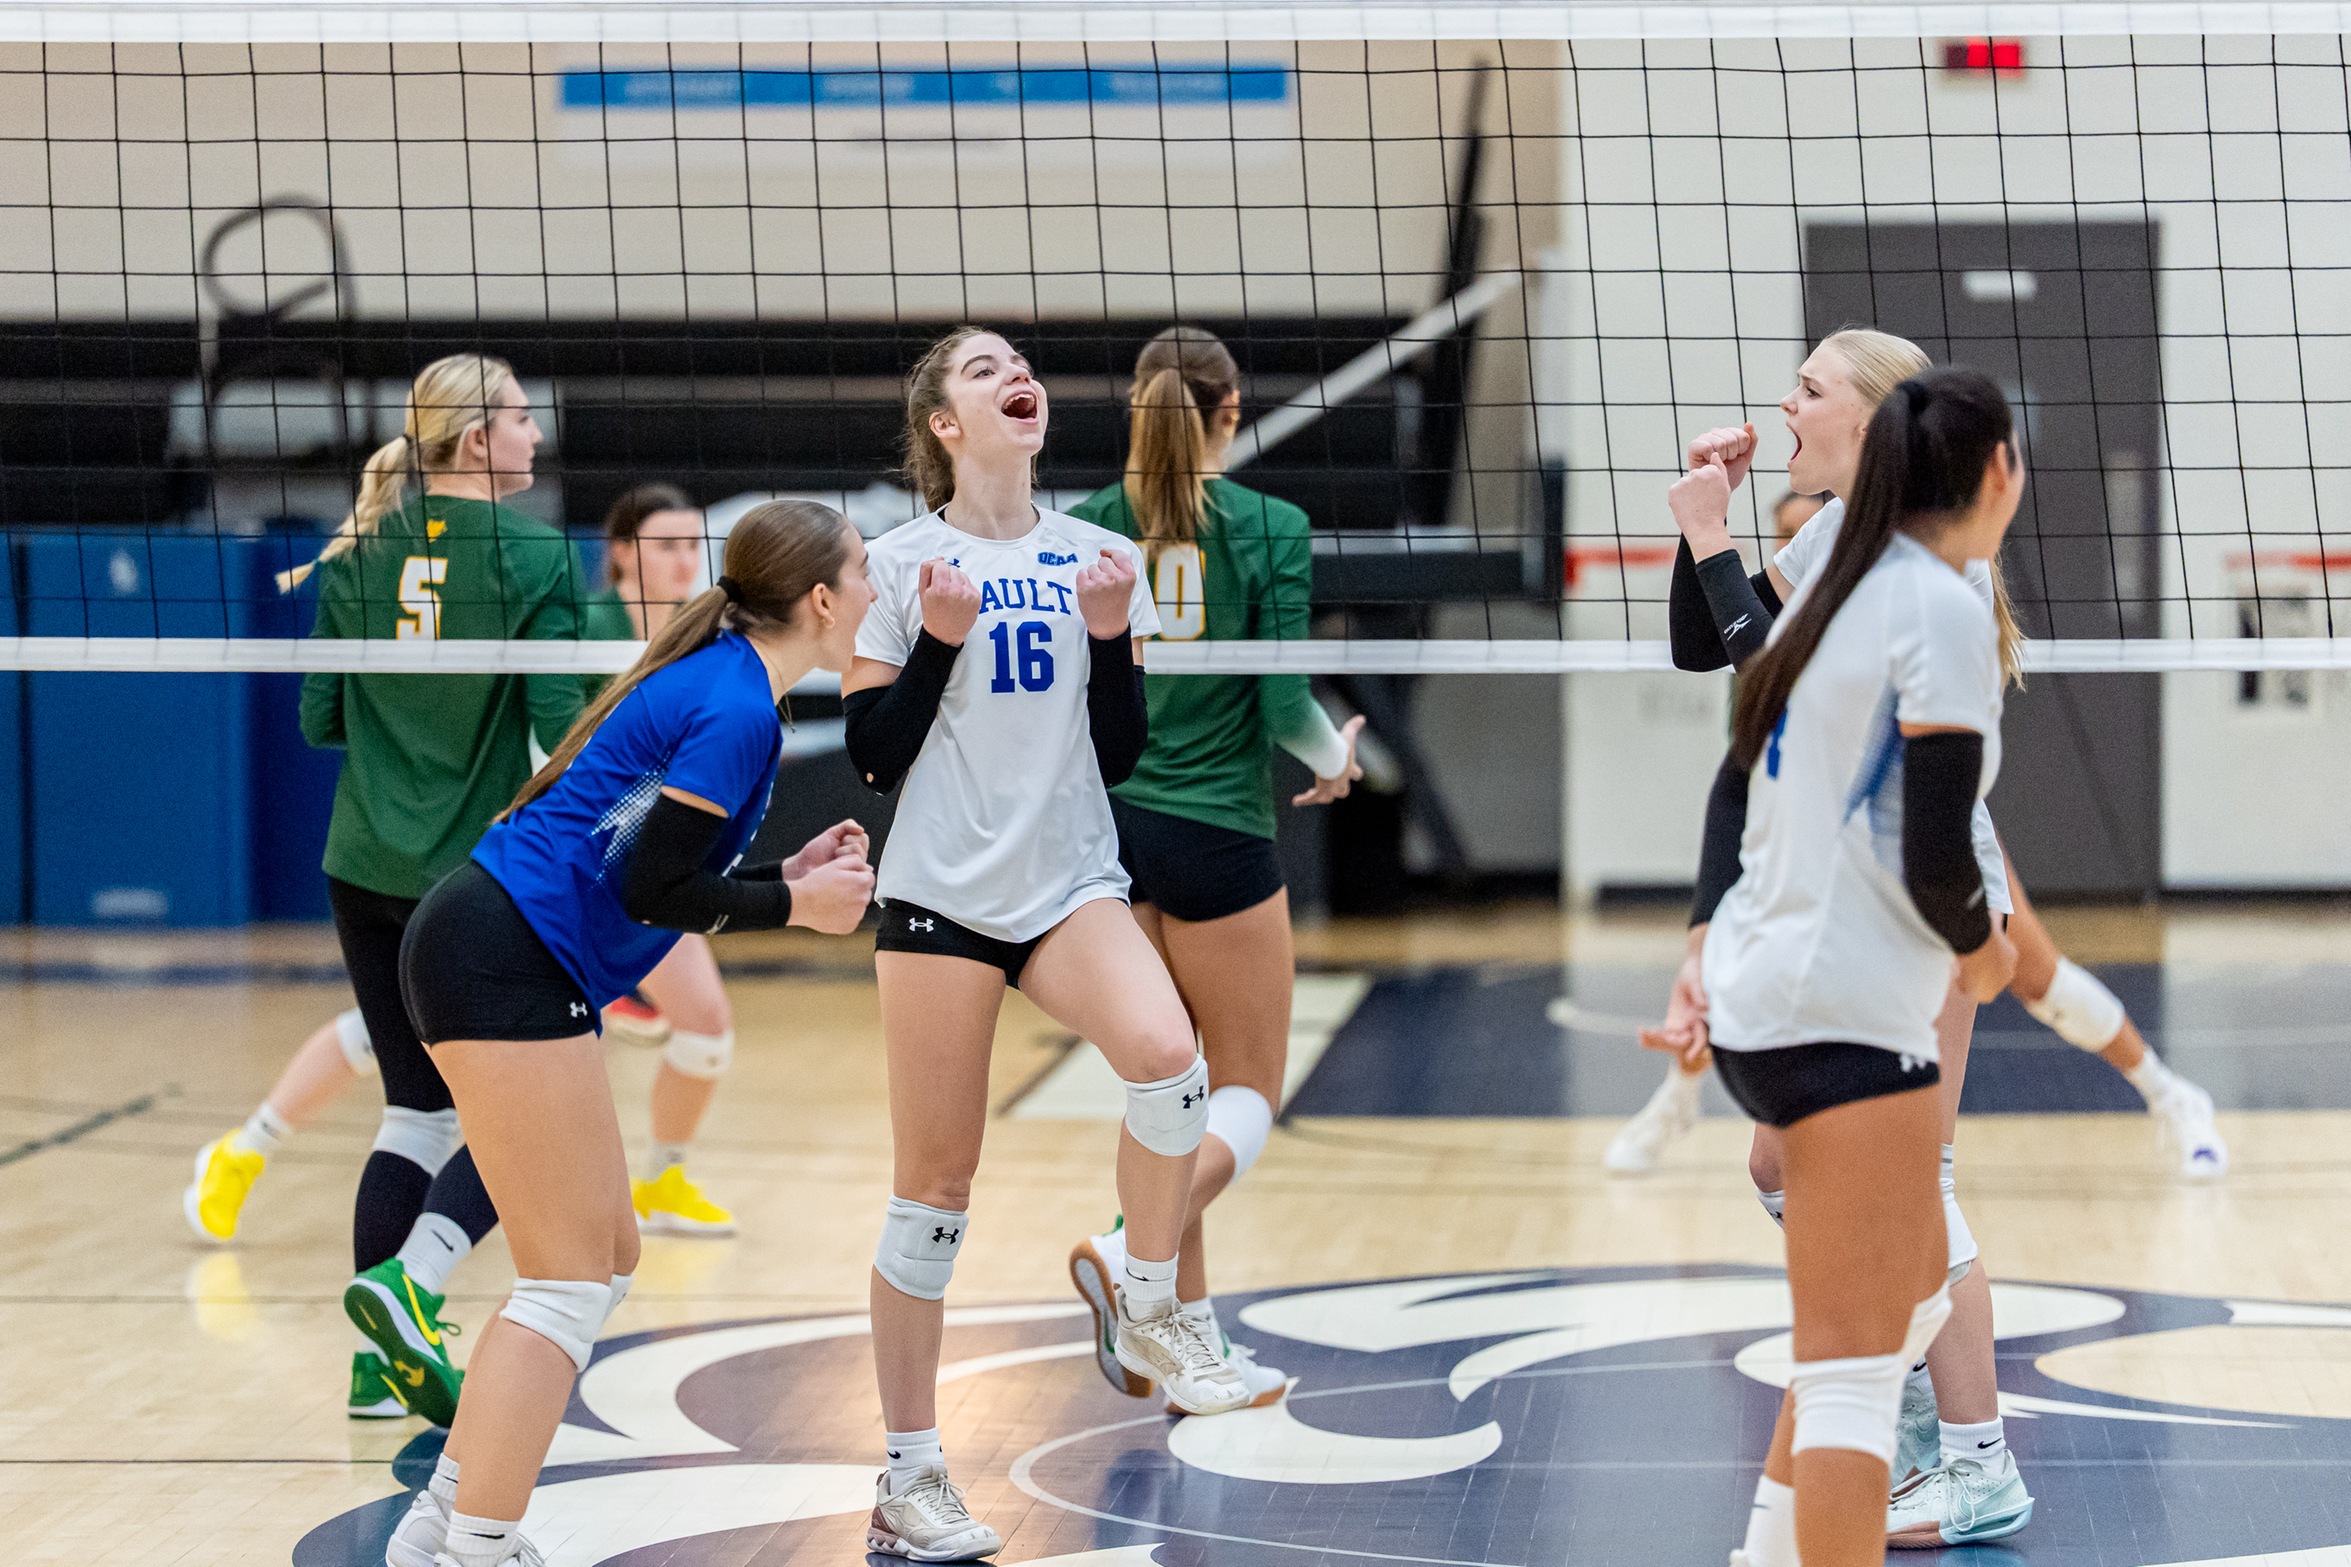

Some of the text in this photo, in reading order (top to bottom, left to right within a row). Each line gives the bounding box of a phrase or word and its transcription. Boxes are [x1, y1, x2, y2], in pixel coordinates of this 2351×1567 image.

[1037, 552, 1078, 566] OCAA
[1135, 541, 1206, 640] 0
[396, 556, 448, 640] 5
[979, 578, 1072, 615] AULT
[989, 621, 1054, 693] 16
